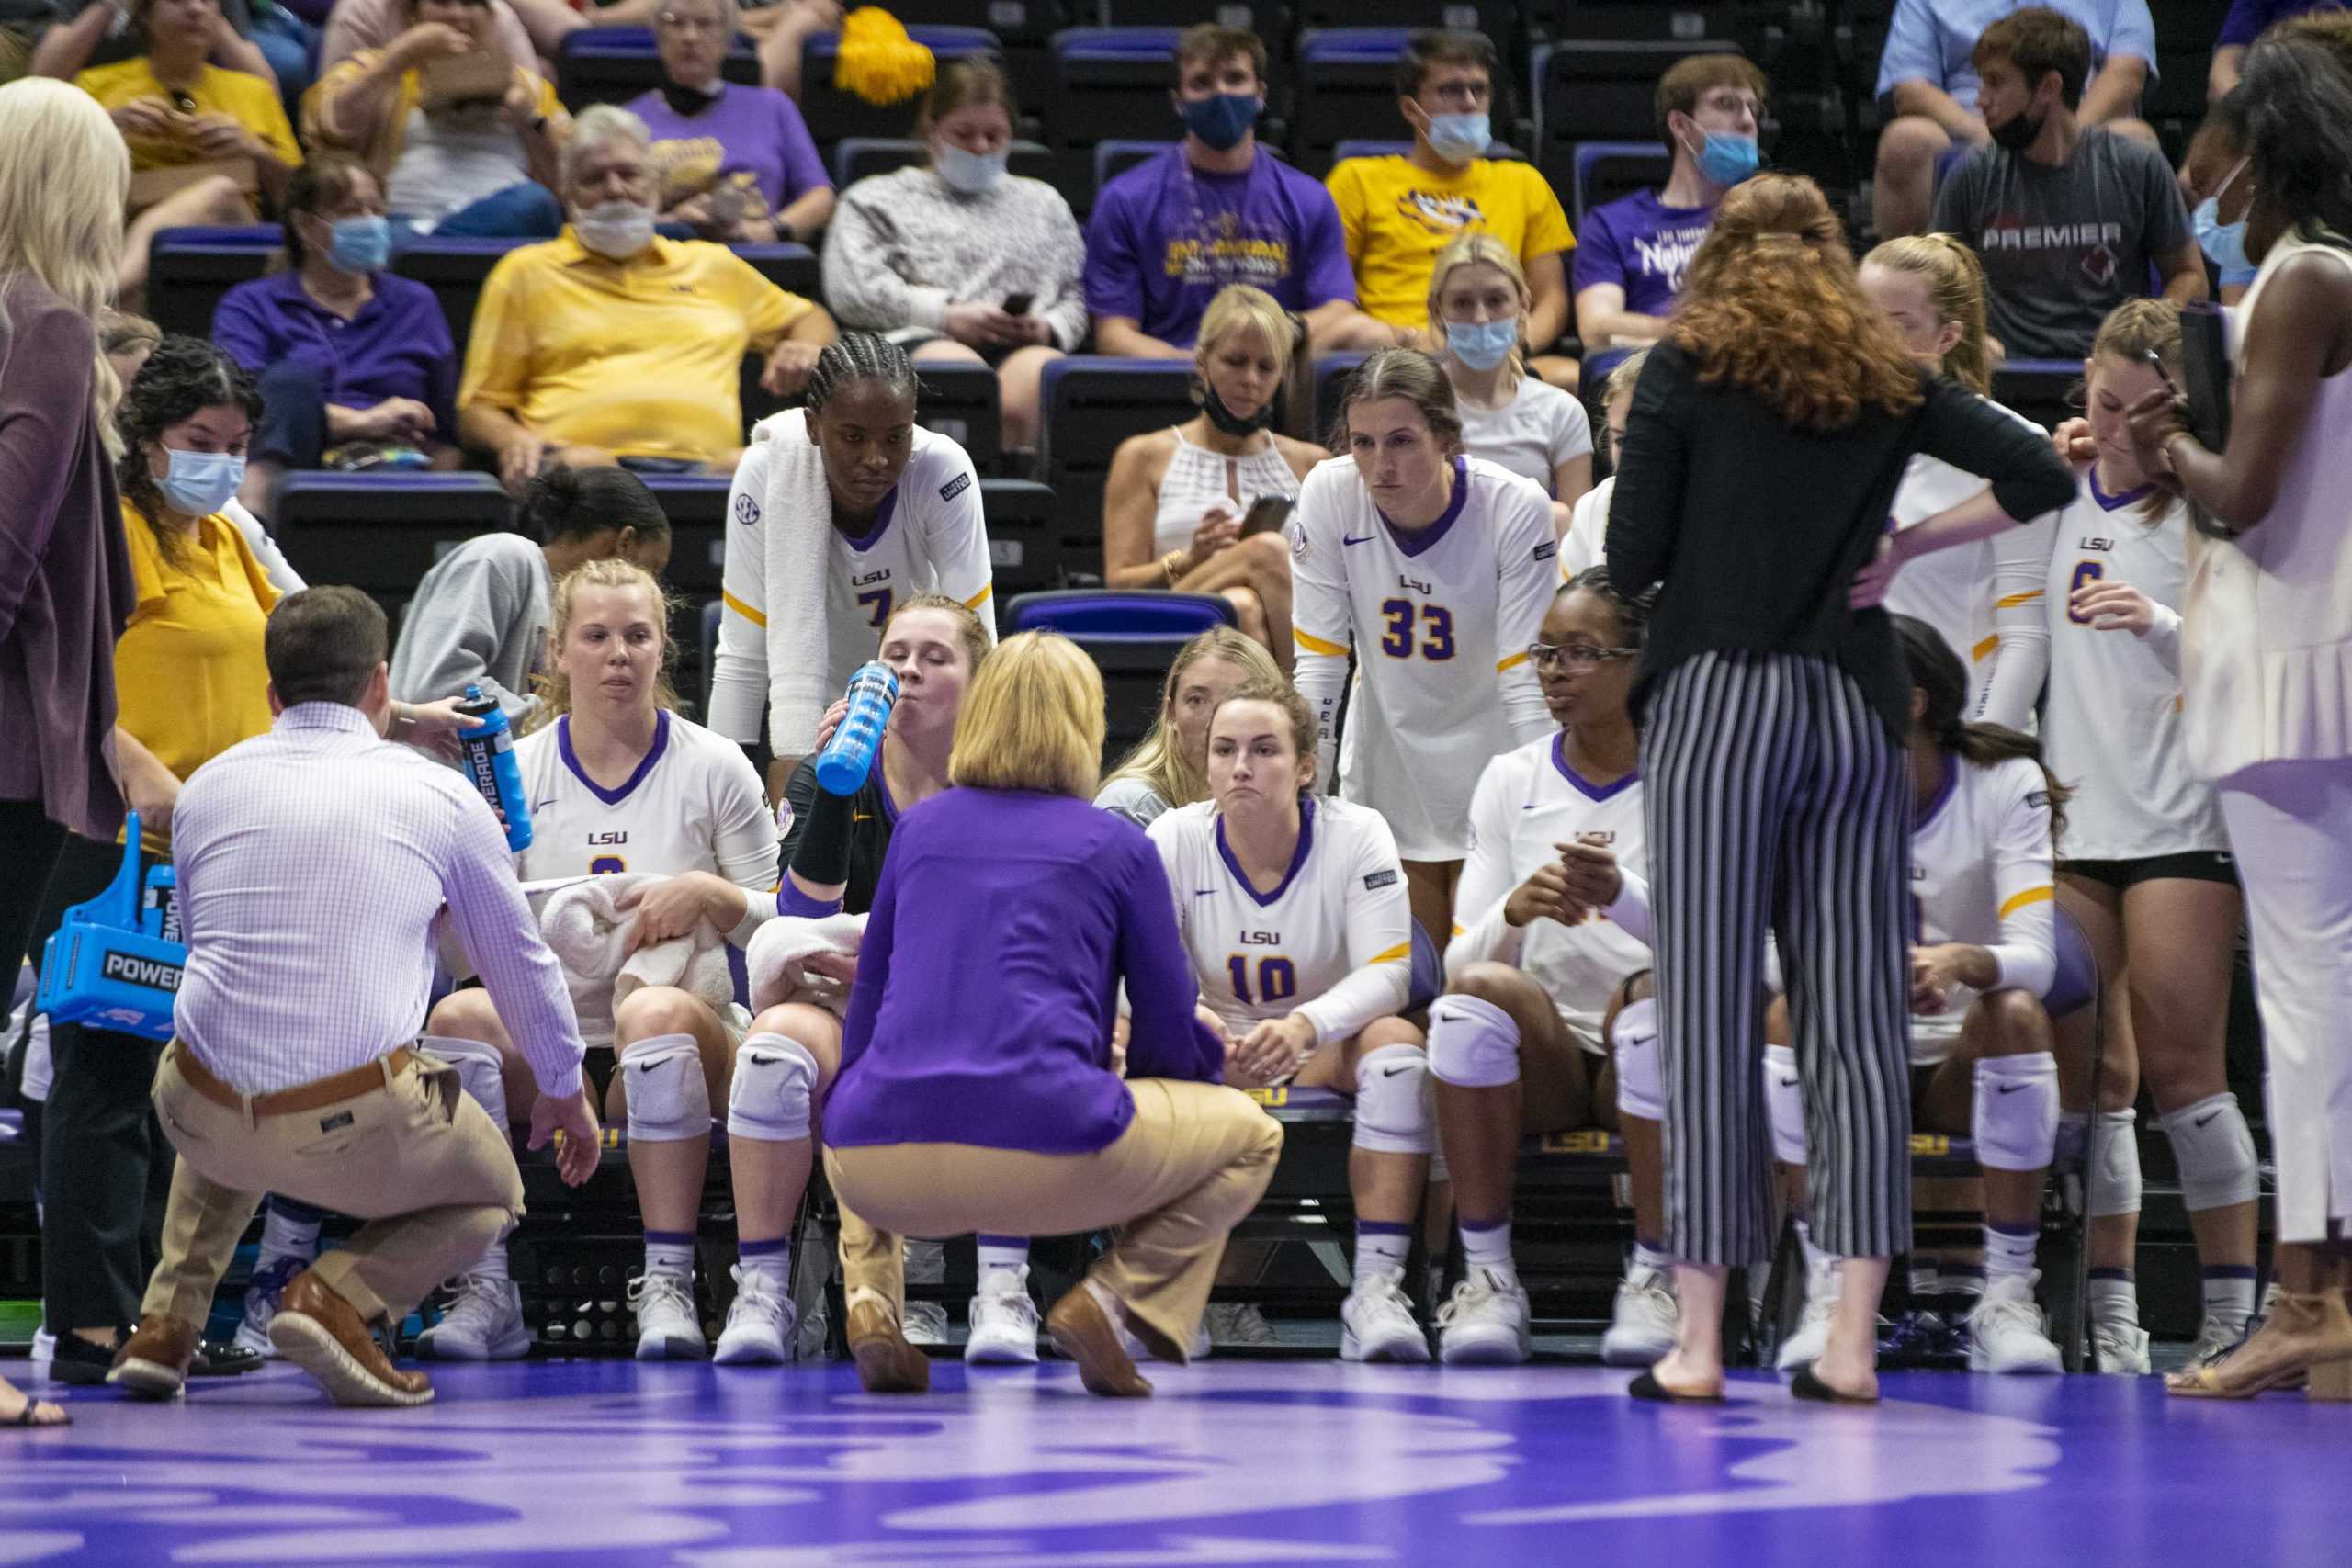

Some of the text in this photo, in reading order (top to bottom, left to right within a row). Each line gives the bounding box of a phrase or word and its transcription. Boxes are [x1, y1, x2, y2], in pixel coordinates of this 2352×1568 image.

[1984, 222, 2122, 251] PREMIER
[736, 500, 760, 523] SEC
[2079, 536, 2116, 552] LSU
[852, 568, 891, 587] LSU
[857, 588, 894, 628] 7
[1381, 597, 1455, 662] 33
[588, 830, 628, 846] LSU
[1240, 930, 1281, 945] LSU
[1227, 953, 1296, 1006] 10
[1543, 1131, 1610, 1153] LSU
